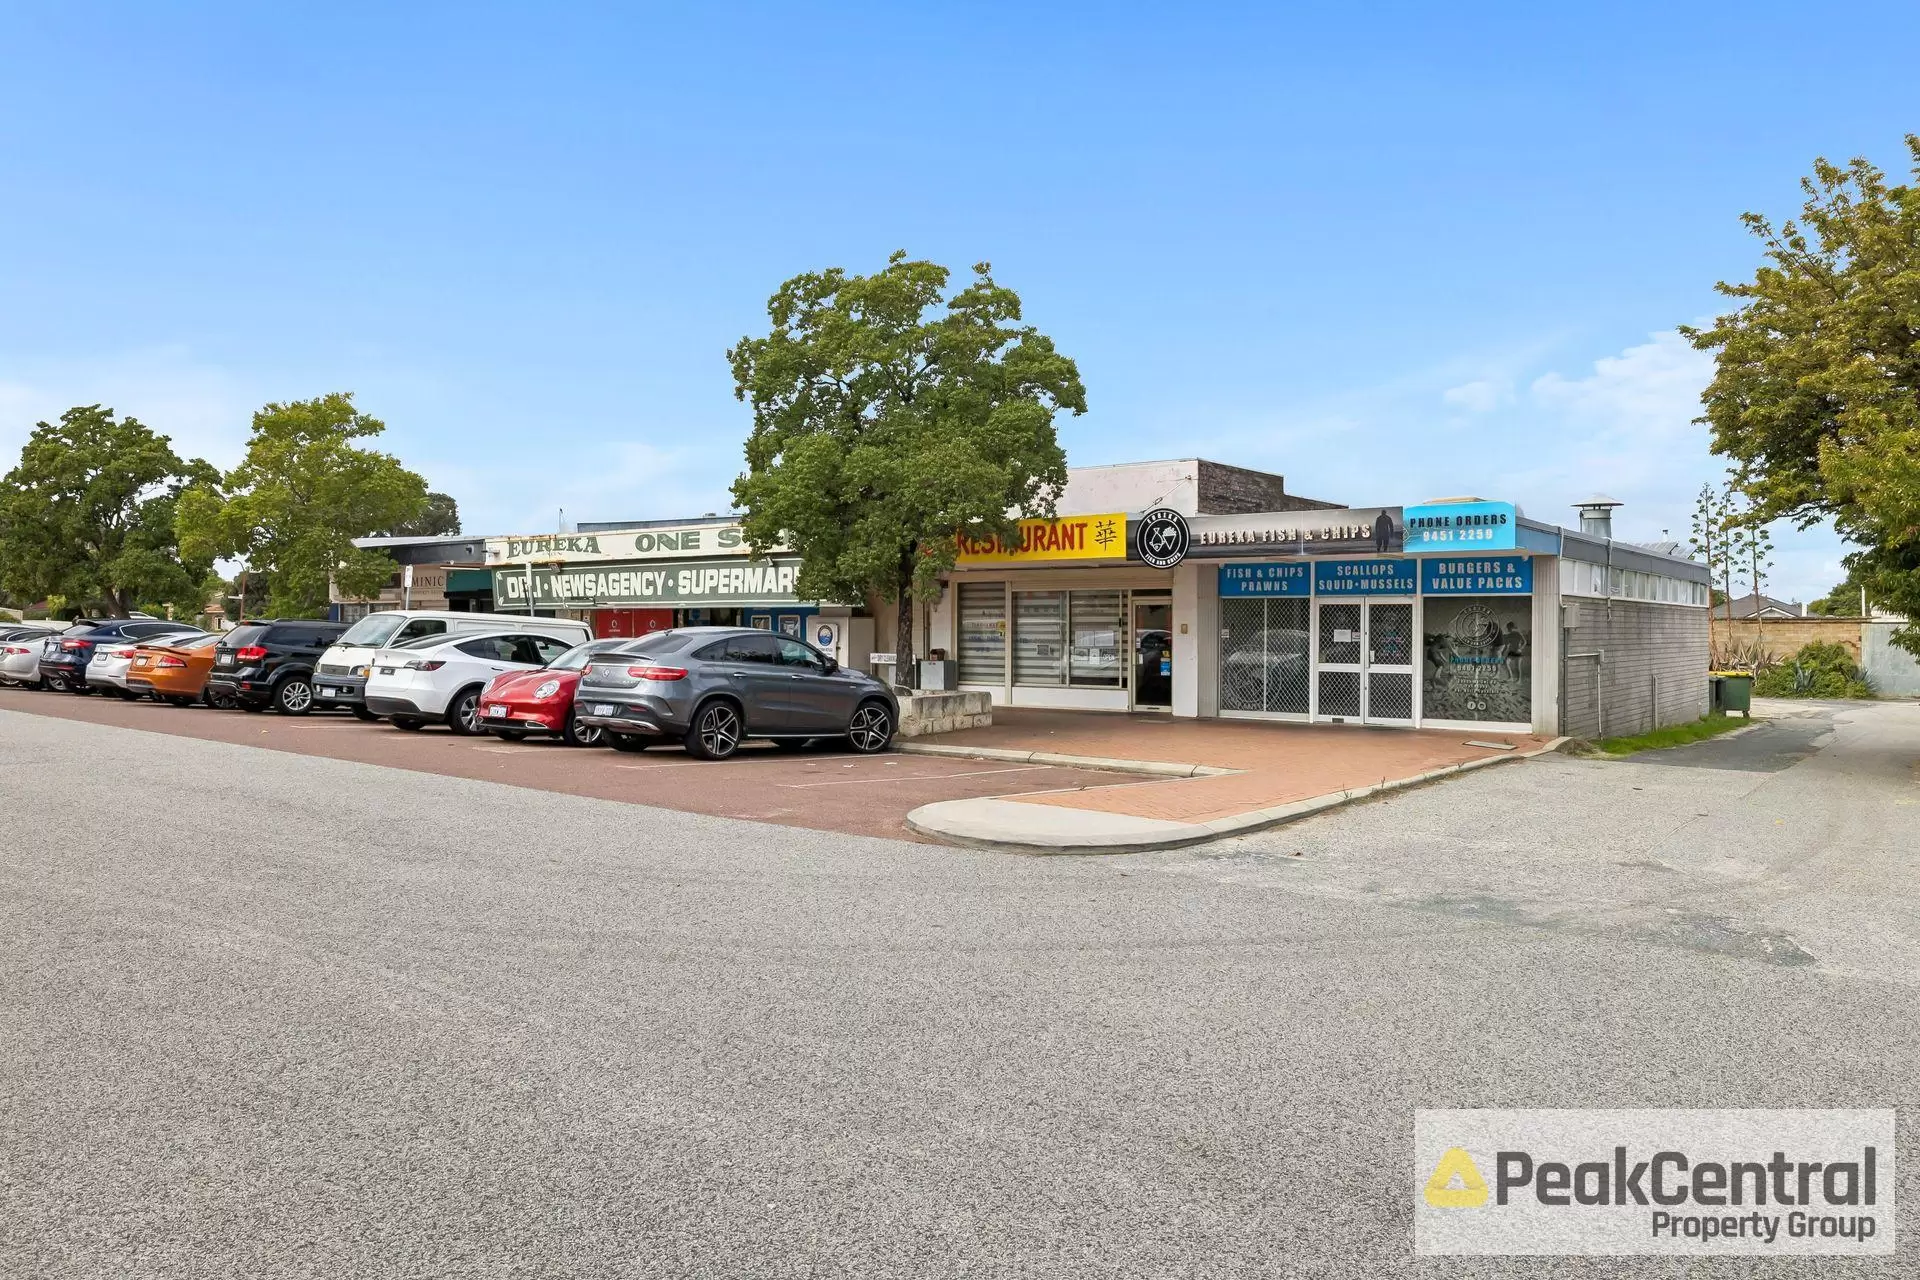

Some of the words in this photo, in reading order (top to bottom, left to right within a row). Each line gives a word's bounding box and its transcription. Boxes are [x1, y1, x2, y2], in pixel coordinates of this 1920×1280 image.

[1410, 516, 1450, 528] PHONE
[1456, 514, 1507, 526] ORDERS
[956, 523, 1088, 556] RESURANT
[1200, 530, 1256, 545] EUREKA
[1262, 528, 1298, 542] FISH
[1304, 529, 1314, 541] &
[1320, 524, 1373, 540] CHIPS
[1423, 530, 1454, 542] 9451
[506, 536, 602, 559] EUREKA
[634, 530, 701, 553] ONE
[1227, 568, 1251, 579] FISH
[1256, 568, 1263, 578] &
[1268, 566, 1304, 578] CHIPS
[1337, 564, 1395, 577] SCALLOPS
[1439, 561, 1501, 575] BURGERS
[1507, 562, 1516, 574] &
[551, 571, 667, 598] NEWSAGENCY
[1241, 581, 1289, 592] PRAWNS
[1432, 577, 1472, 590] VALUE
[1478, 576, 1524, 589] PACKS
